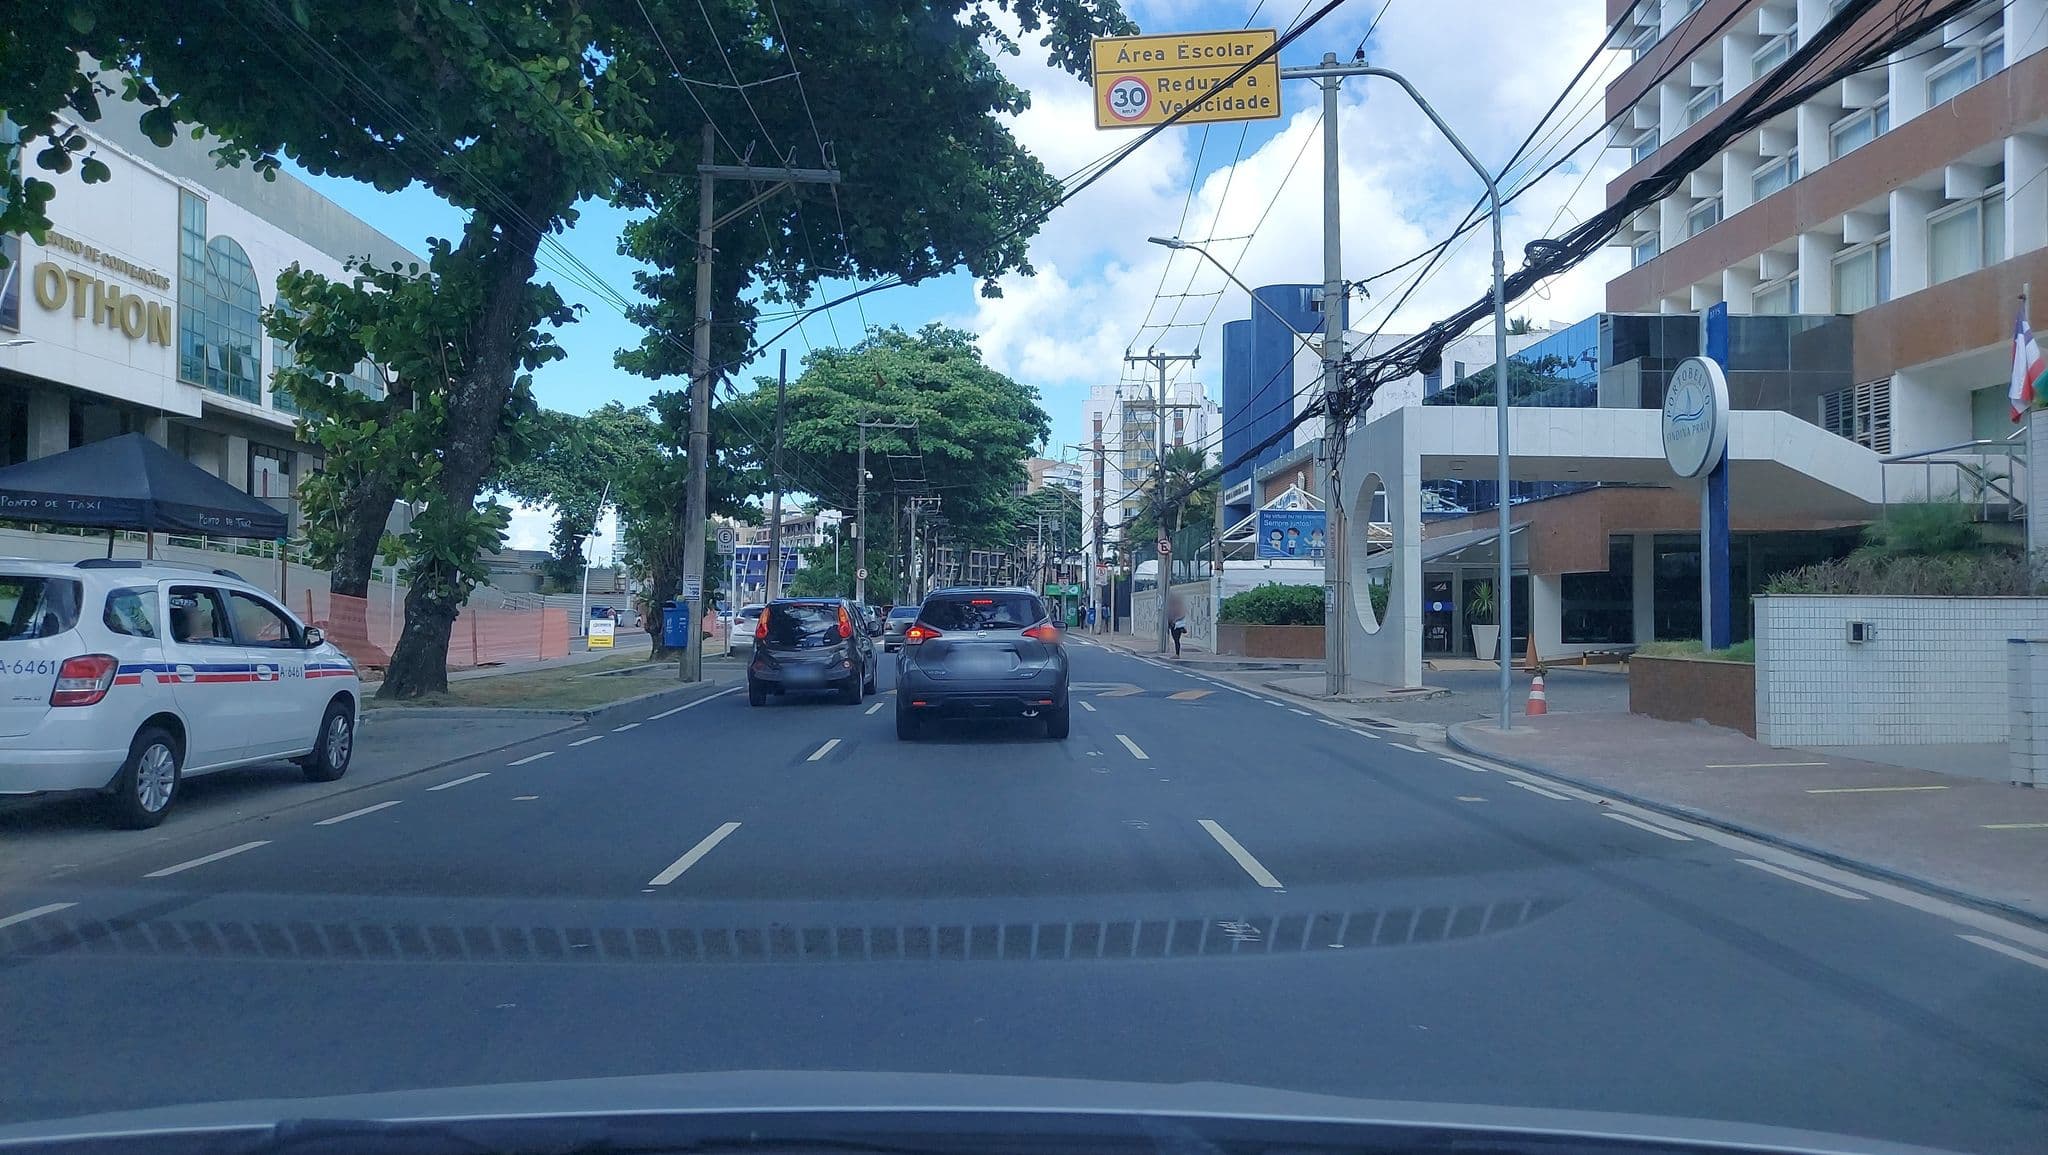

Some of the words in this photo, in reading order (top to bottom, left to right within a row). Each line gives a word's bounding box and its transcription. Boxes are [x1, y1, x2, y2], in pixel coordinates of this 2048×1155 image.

[1116, 43, 1165, 64] Área
[1177, 42, 1255, 60] Escolar
[1246, 75, 1258, 87] a
[1113, 87, 1146, 107] 30
[84, 245, 101, 262] DE
[34, 261, 171, 347] OTHON
[1667, 367, 1712, 419] PORTOBELLO
[1, 495, 38, 507] PONTO
[44, 500, 58, 509] DE
[67, 500, 102, 510] TAXI
[1263, 519, 1289, 527] Sempre
